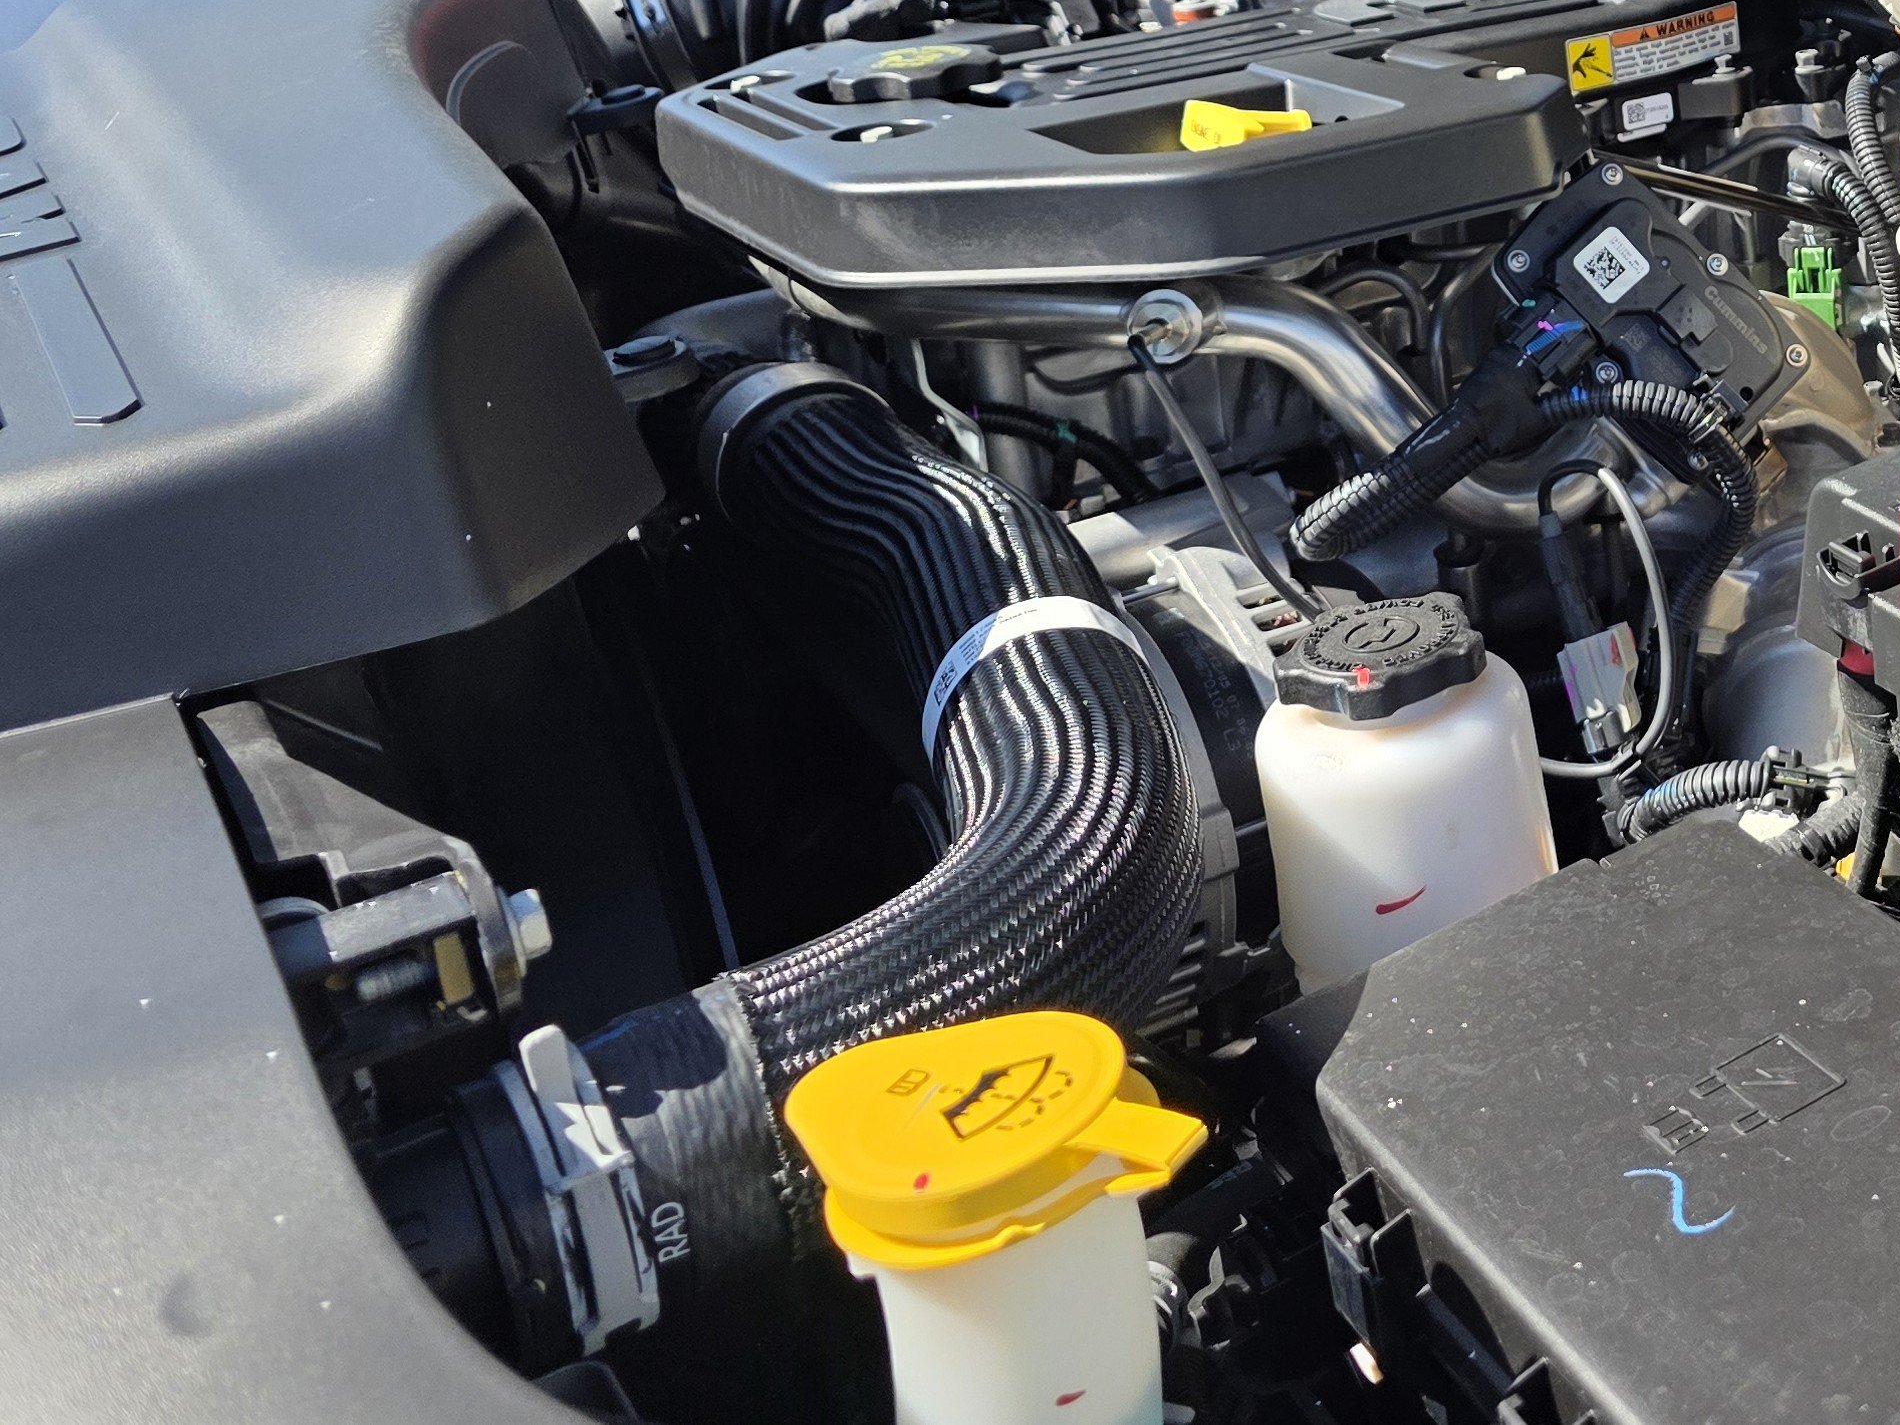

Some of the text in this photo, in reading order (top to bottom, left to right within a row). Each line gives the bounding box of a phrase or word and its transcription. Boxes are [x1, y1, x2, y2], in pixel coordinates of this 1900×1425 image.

[1656, 11, 1715, 35] WARNING
[1704, 285, 1768, 355] Cummins
[657, 1199, 691, 1265] RAD
